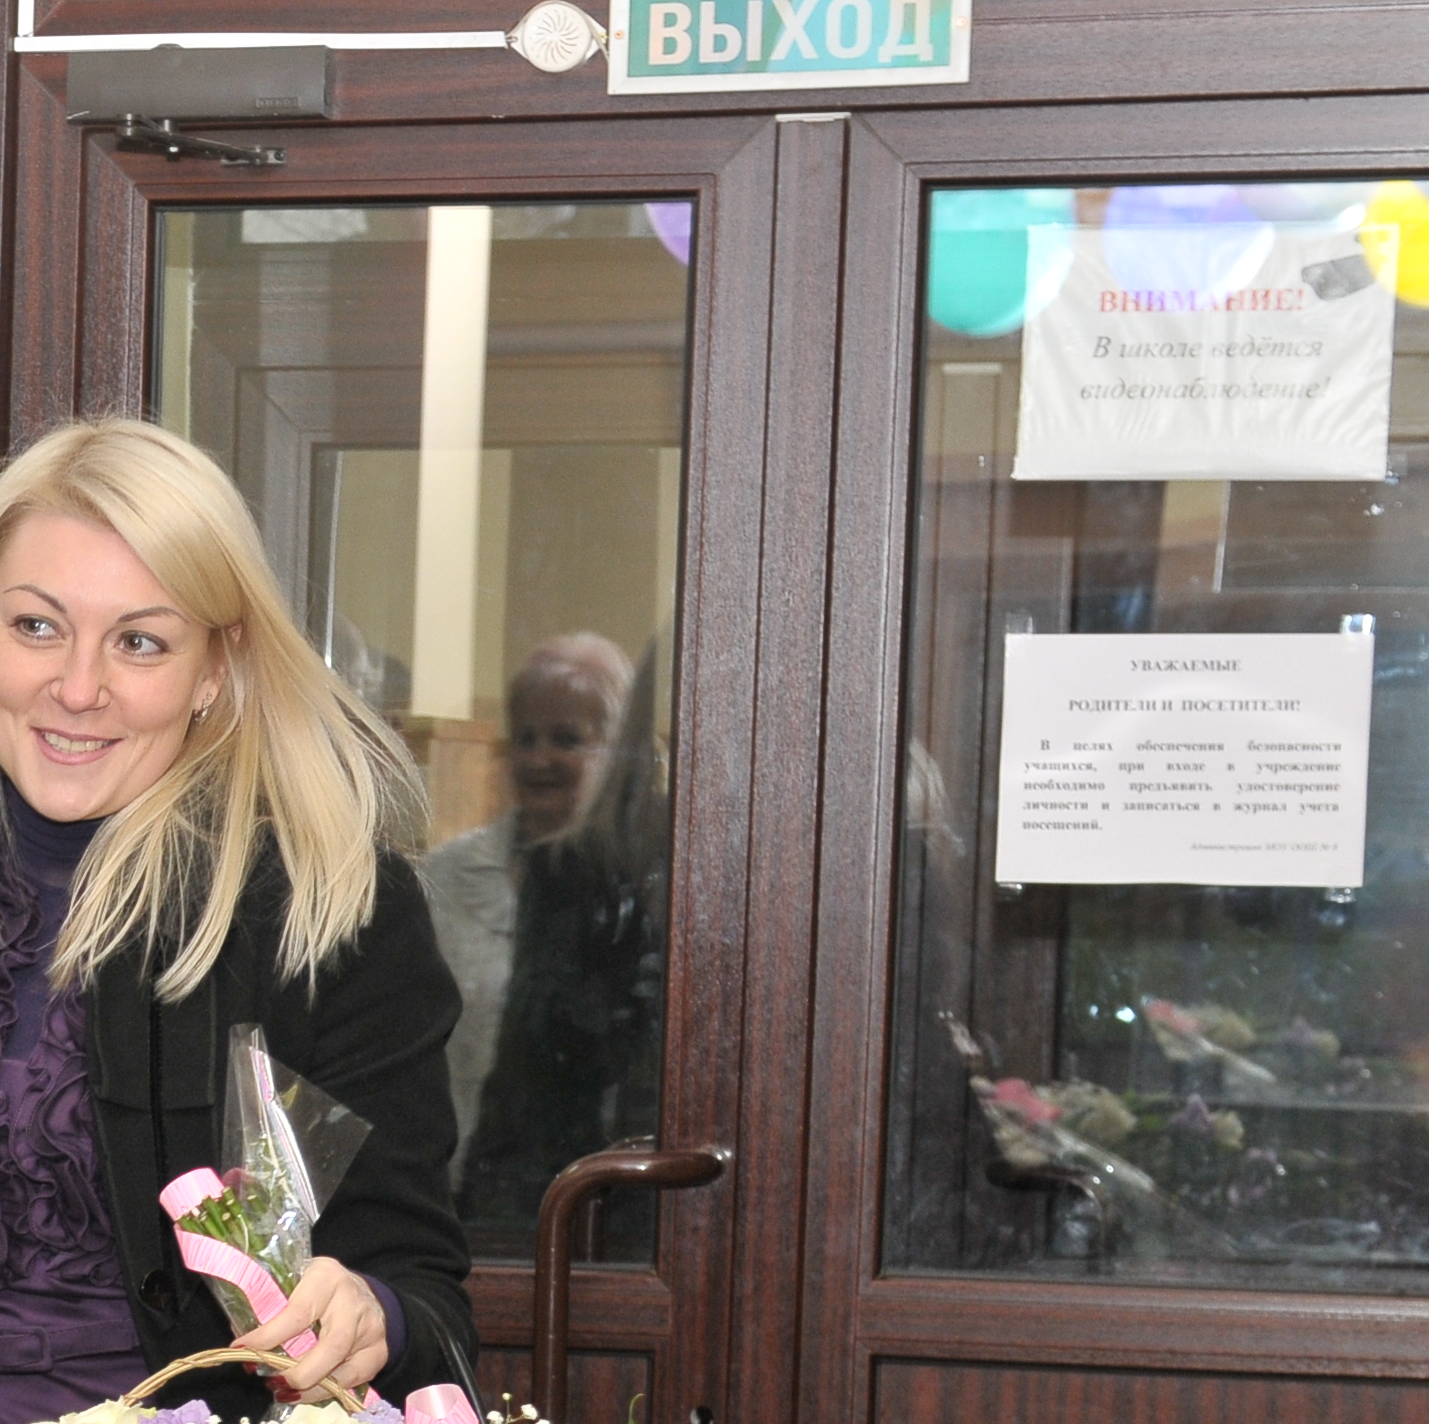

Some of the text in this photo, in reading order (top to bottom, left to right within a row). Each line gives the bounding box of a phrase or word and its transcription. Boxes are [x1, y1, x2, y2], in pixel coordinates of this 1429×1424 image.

[647, 0, 934, 65] ВЫХОД
[1098, 288, 1306, 313] ВНИМАНИЕ!
[1093, 334, 1324, 358] В школе ведётся
[1079, 376, 1332, 401] видеонаблюдение!
[1130, 659, 1242, 672] УВАЖАЕМЫЕ
[1068, 699, 1301, 713] РОДИТЕЛИ И ПОСЕТИТЕЛИ!
[1040, 739, 1342, 752] В целях обеспечения безопасности
[1024, 761, 1341, 775] учащихся, при входе в учреждение
[1023, 779, 1341, 794] необходимо предъявить удостоверение
[1022, 801, 1089, 811] личности
[1101, 802, 1110, 811] и
[1123, 802, 1200, 812] записаться
[1212, 802, 1221, 811] в
[1233, 802, 1287, 814] журнал
